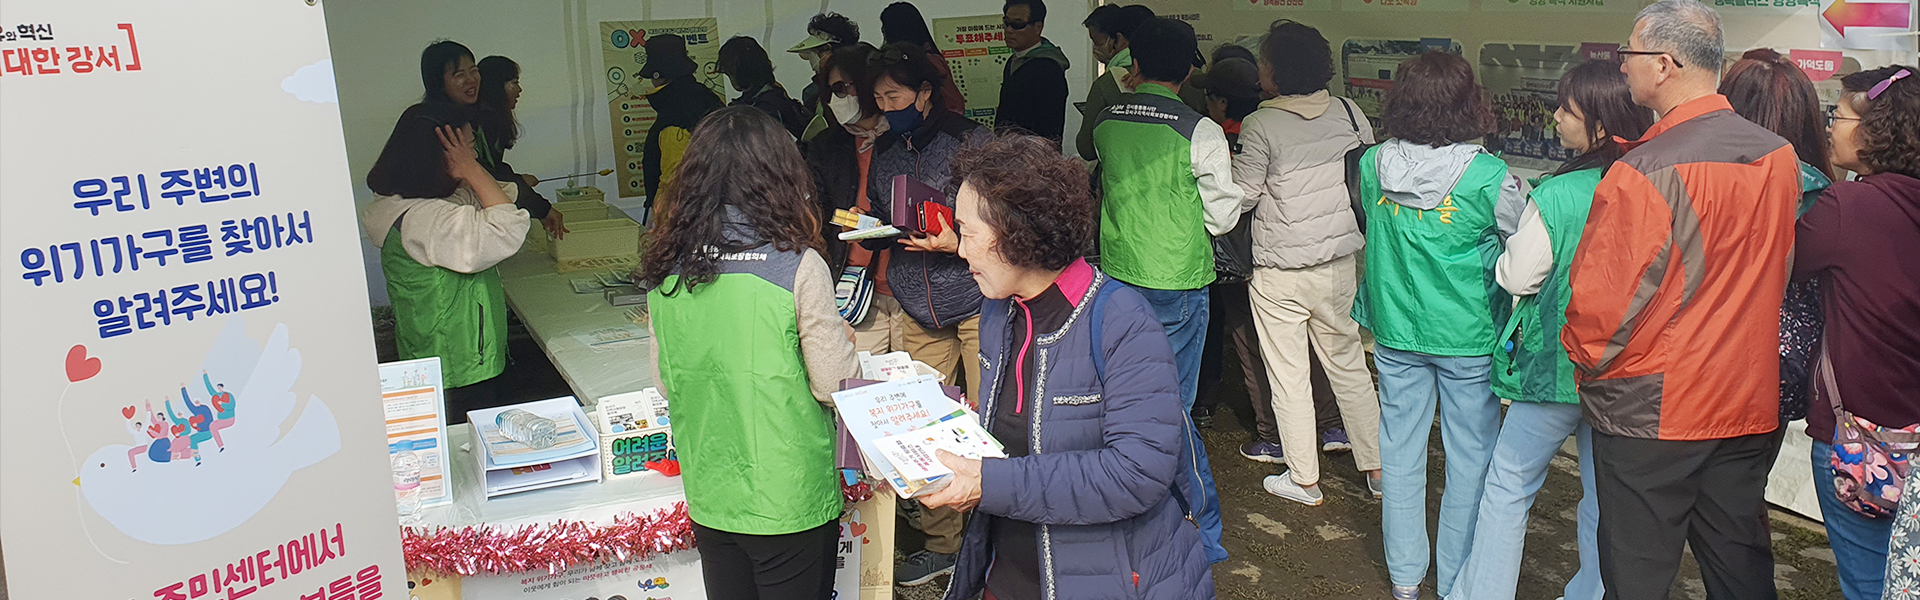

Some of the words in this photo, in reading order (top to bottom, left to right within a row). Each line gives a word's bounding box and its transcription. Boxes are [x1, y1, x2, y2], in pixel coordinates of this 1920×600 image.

[956, 32, 1005, 44] 투표해주세
[0, 46, 61, 76] 대한
[73, 174, 150, 216] 우리
[160, 162, 260, 206] 주변의
[20, 223, 213, 286] 위기가구를
[220, 210, 313, 256] 찾아서
[93, 271, 280, 339] 알려주세요!
[875, 395, 888, 404] 우리
[868, 407, 885, 418] 복지
[890, 409, 931, 426] 알려주세요!
[612, 432, 668, 457] 어려운
[612, 449, 678, 475] 알려주
[523, 584, 551, 594] 이웃에게
[567, 577, 582, 586] 되는
[611, 567, 631, 577] 행복한
[567, 568, 588, 577] 우리가
